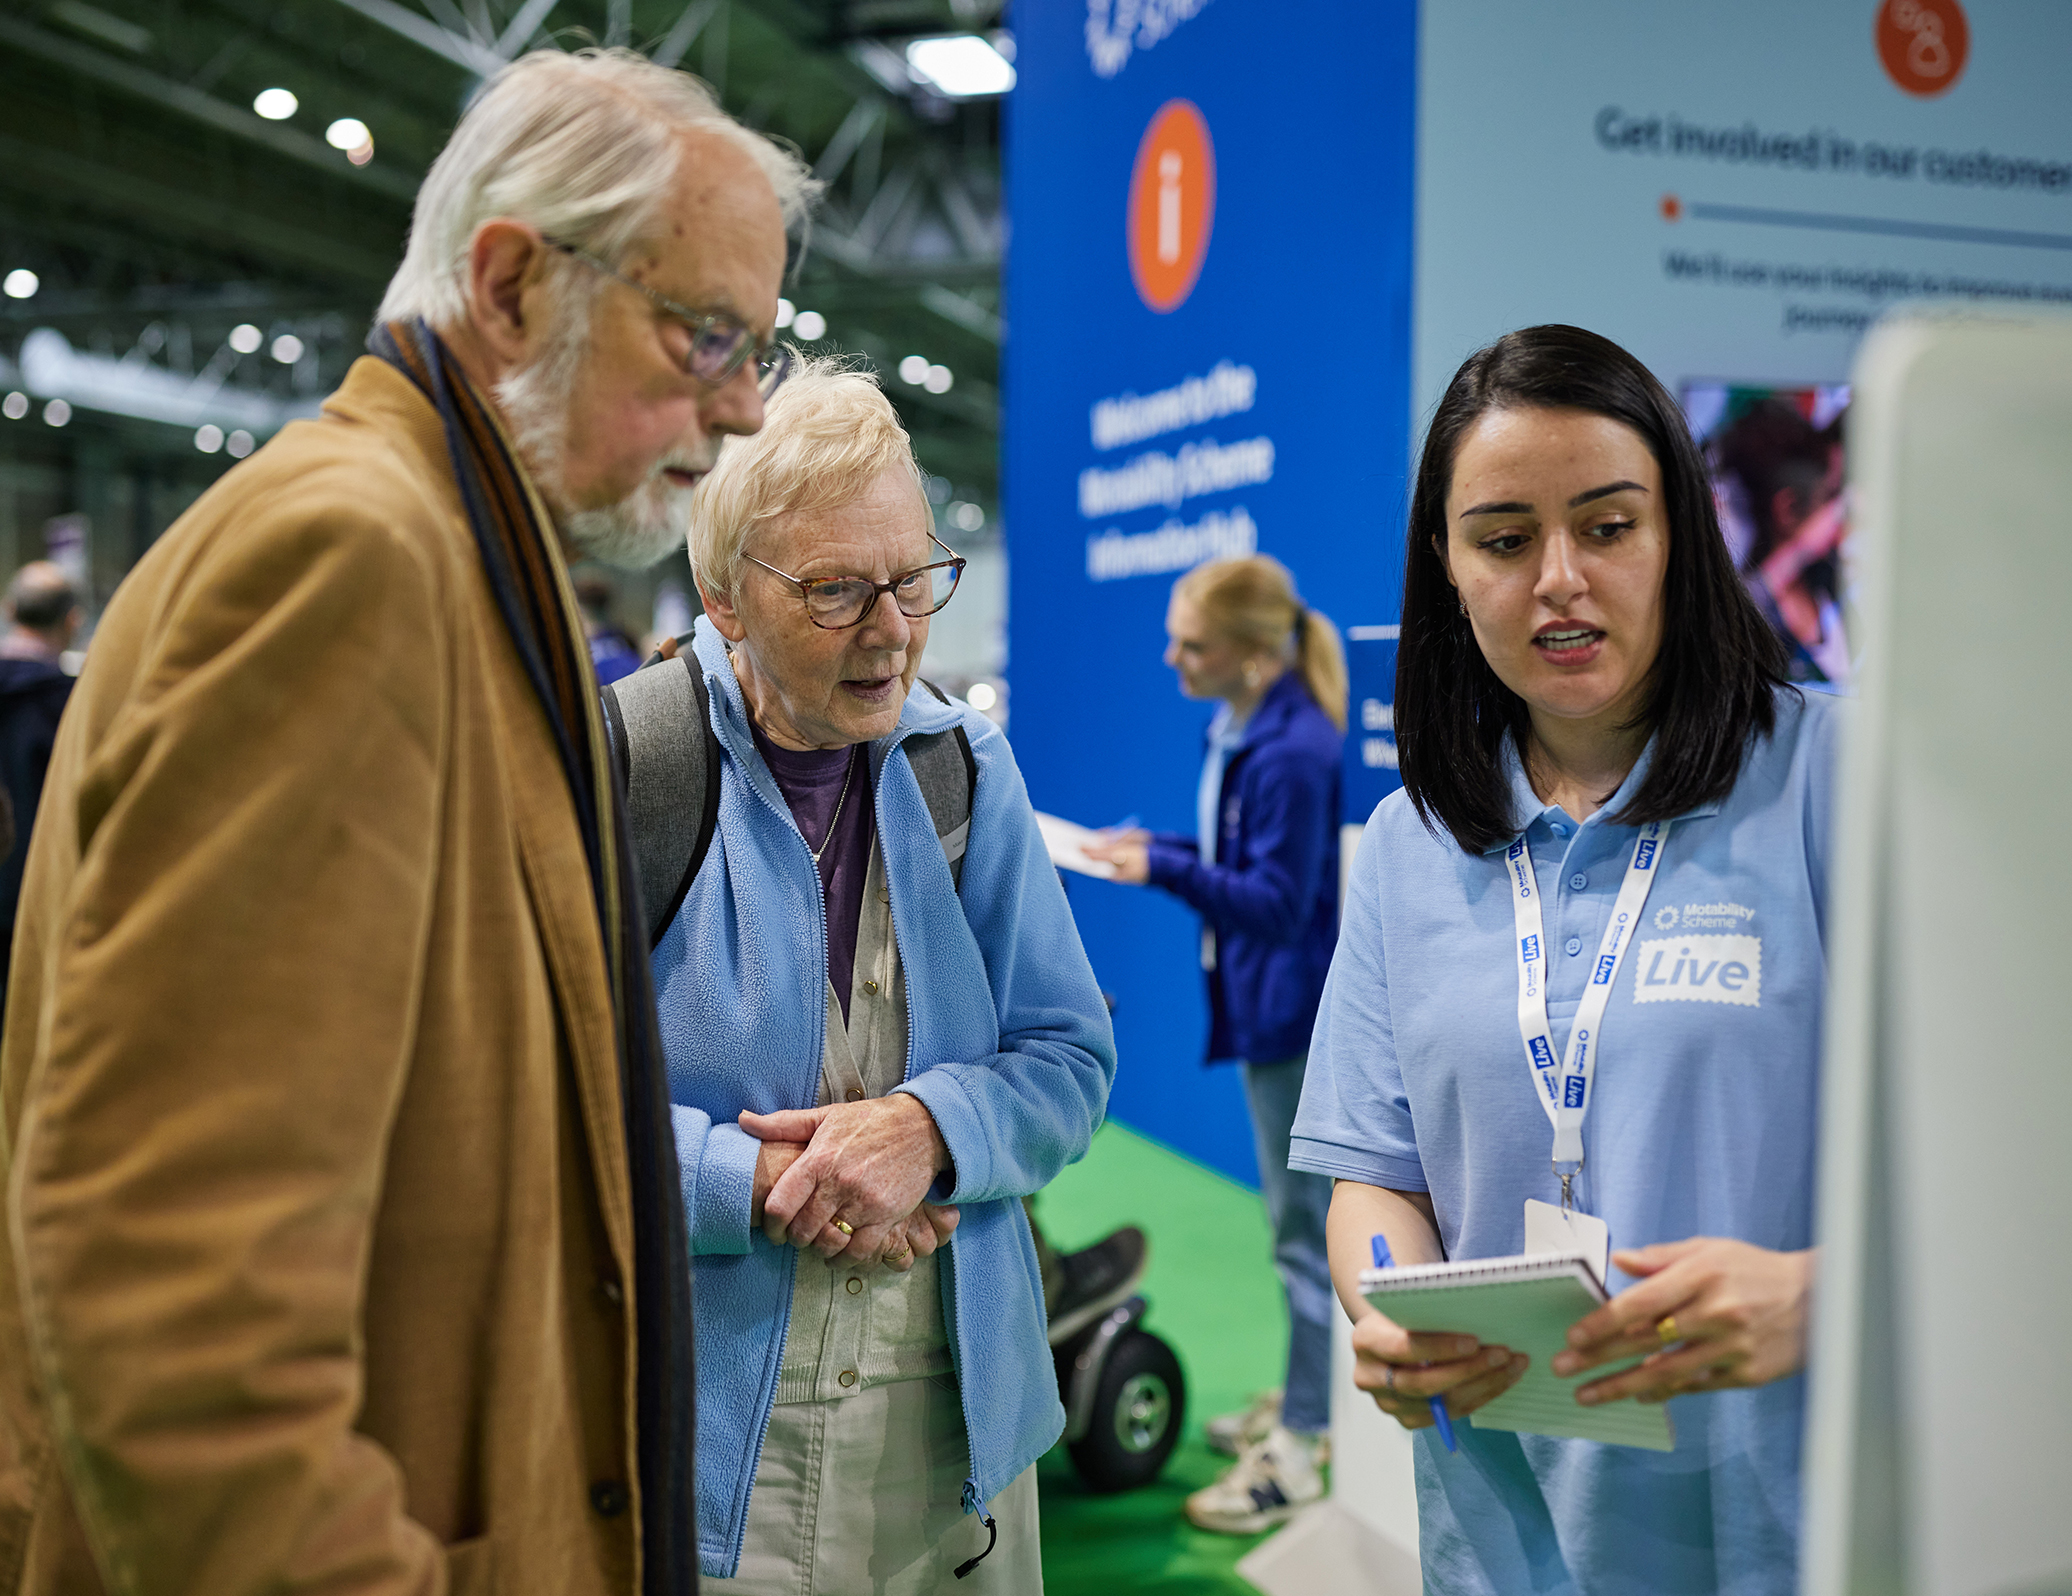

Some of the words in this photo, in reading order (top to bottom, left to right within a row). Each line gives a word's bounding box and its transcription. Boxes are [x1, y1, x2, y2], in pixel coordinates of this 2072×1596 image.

[1594, 105, 1661, 154] Get
[1668, 112, 1819, 172] involved
[1829, 129, 1856, 170] in
[1862, 142, 1917, 180] our
[1637, 841, 1654, 868] Live
[1681, 916, 1738, 928] Scheme
[1683, 902, 1756, 921] Motability
[1523, 935, 1539, 960] Live
[1595, 956, 1614, 984] Live
[1644, 947, 1749, 991] Live
[1535, 1038, 1551, 1067] Live
[1566, 1077, 1583, 1107] Live
